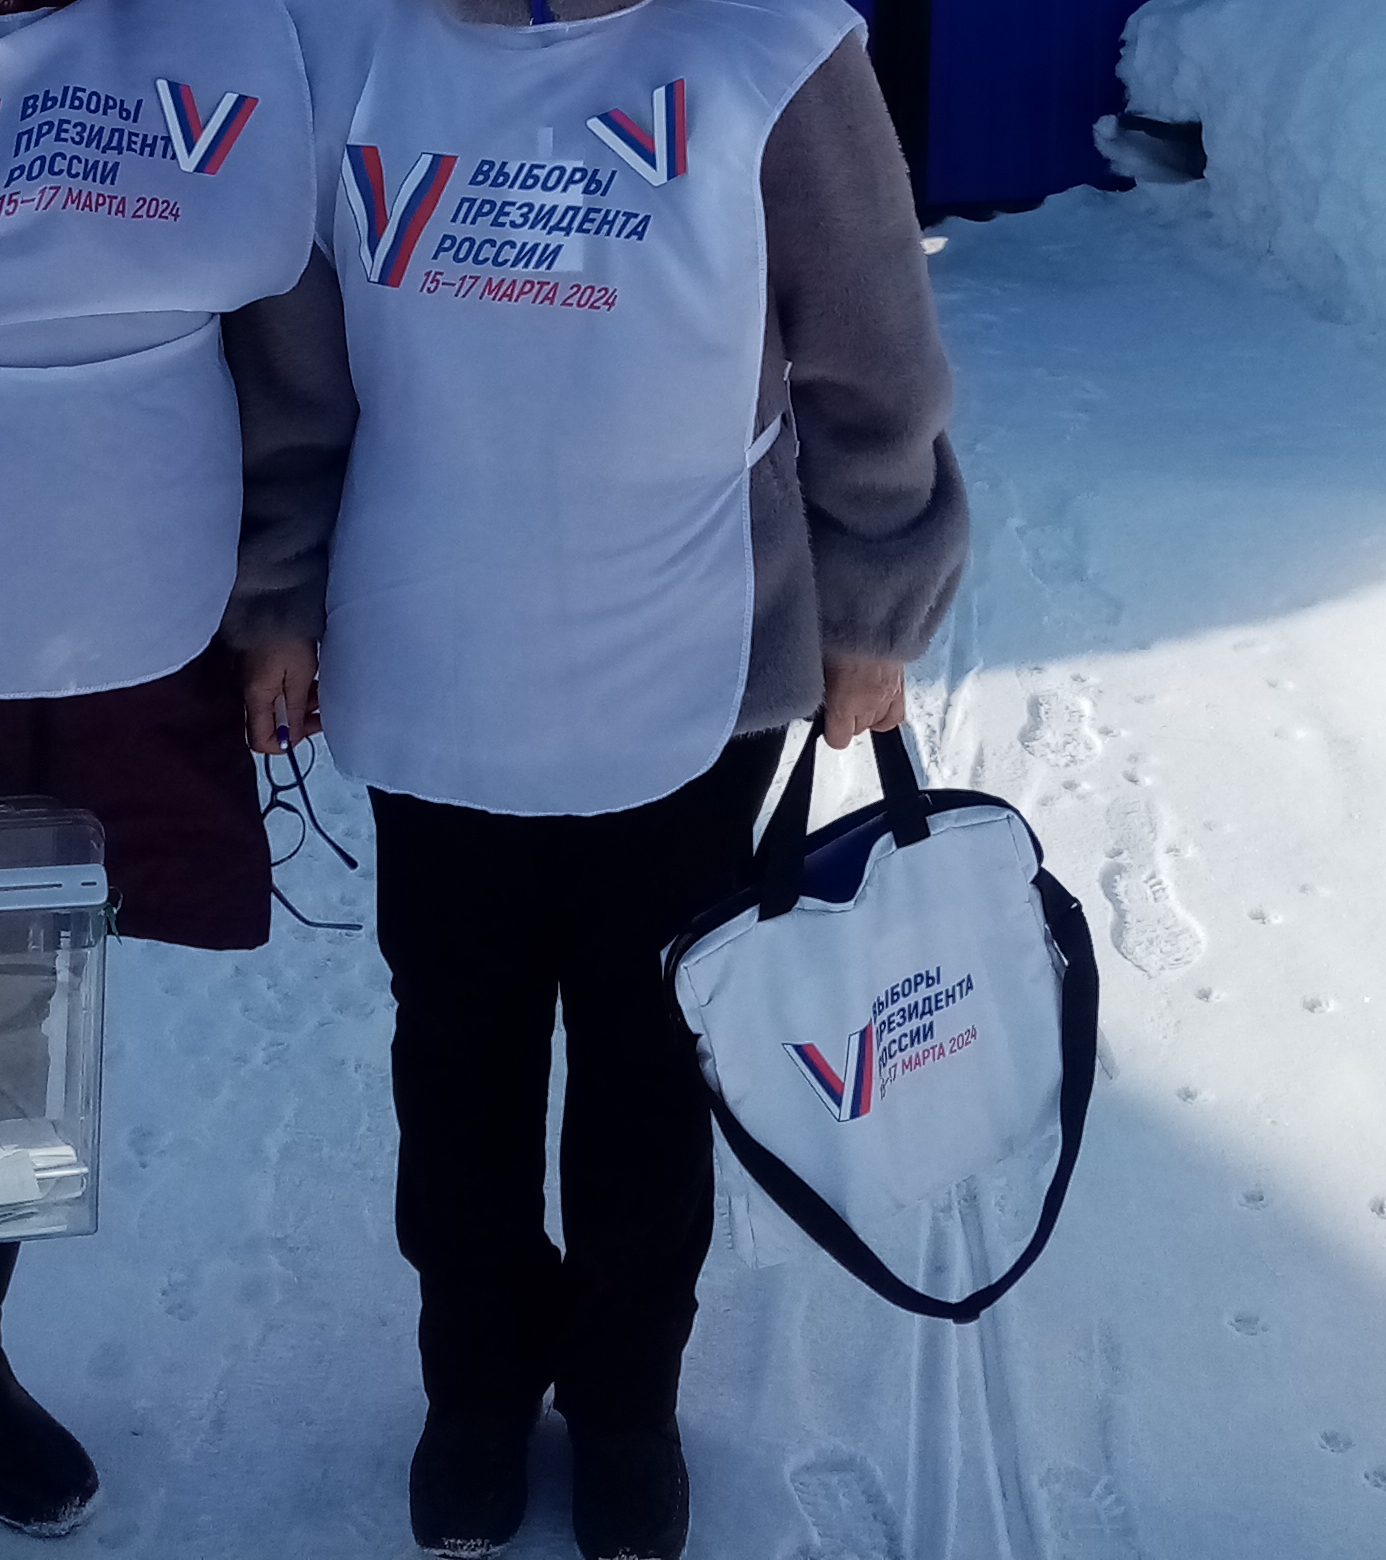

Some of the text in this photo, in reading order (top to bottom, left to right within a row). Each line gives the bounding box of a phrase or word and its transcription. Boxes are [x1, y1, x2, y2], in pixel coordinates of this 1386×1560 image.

[19, 85, 143, 123] ВЫБОРЫ
[13, 118, 177, 161] ПРЕЗИДЕНТ
[3, 151, 120, 189] РОССИИ
[468, 158, 617, 197] ВЫБОРЫ
[61, 187, 126, 218] МАРТА
[131, 197, 181, 222] 2024
[450, 196, 652, 242] ПРЕЗИДЕНТА
[431, 234, 564, 271] РОССИИ
[479, 277, 559, 306] МАРТА
[560, 283, 618, 312] 2024
[901, 1042, 946, 1076] МАРТА
[949, 1024, 977, 1054] 2024
